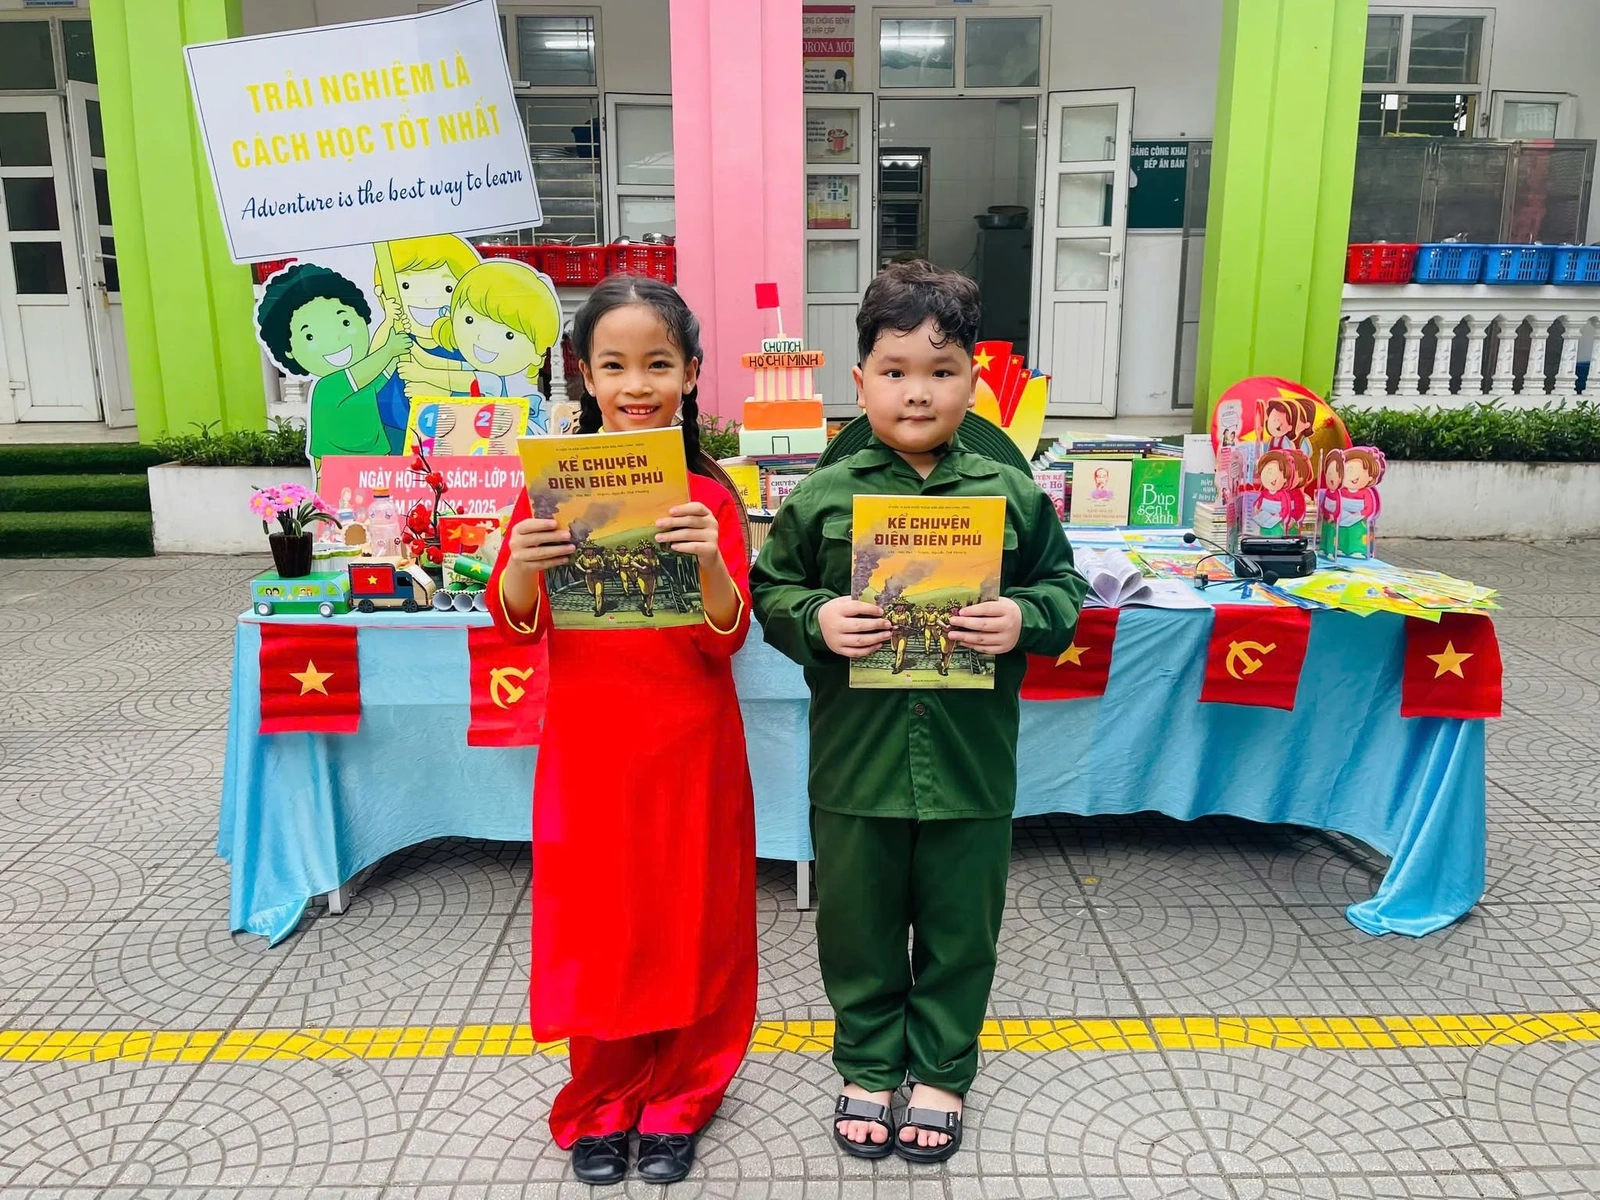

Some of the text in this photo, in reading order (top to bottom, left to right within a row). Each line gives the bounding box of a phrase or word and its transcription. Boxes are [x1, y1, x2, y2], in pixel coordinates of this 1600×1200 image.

[246, 50, 471, 114] TRẢI NGHIỆM LÀ
[231, 96, 501, 169] CÁCH HỌC TỐT NHẤT
[1150, 145, 1170, 156] CÔNG
[1170, 146, 1187, 156] KHAI
[241, 163, 523, 220] Adventure is the best way to learn
[787, 354, 818, 366] MINH
[424, 412, 434, 427] 1
[476, 411, 491, 426] 2
[558, 453, 648, 472] KỂ CHUYỆN
[359, 466, 392, 488] NGÀY
[446, 467, 478, 488] SÁCH
[484, 466, 506, 488] LỚP
[548, 468, 664, 492] ĐIỆN BIÊN PHỦ
[1142, 483, 1176, 510] Búp
[1136, 504, 1162, 516] sen
[1144, 510, 1174, 524] xanh
[888, 513, 970, 531] KỂ CHUYỆN
[874, 530, 982, 548] ĐIỆN BIÊN PHỦ
